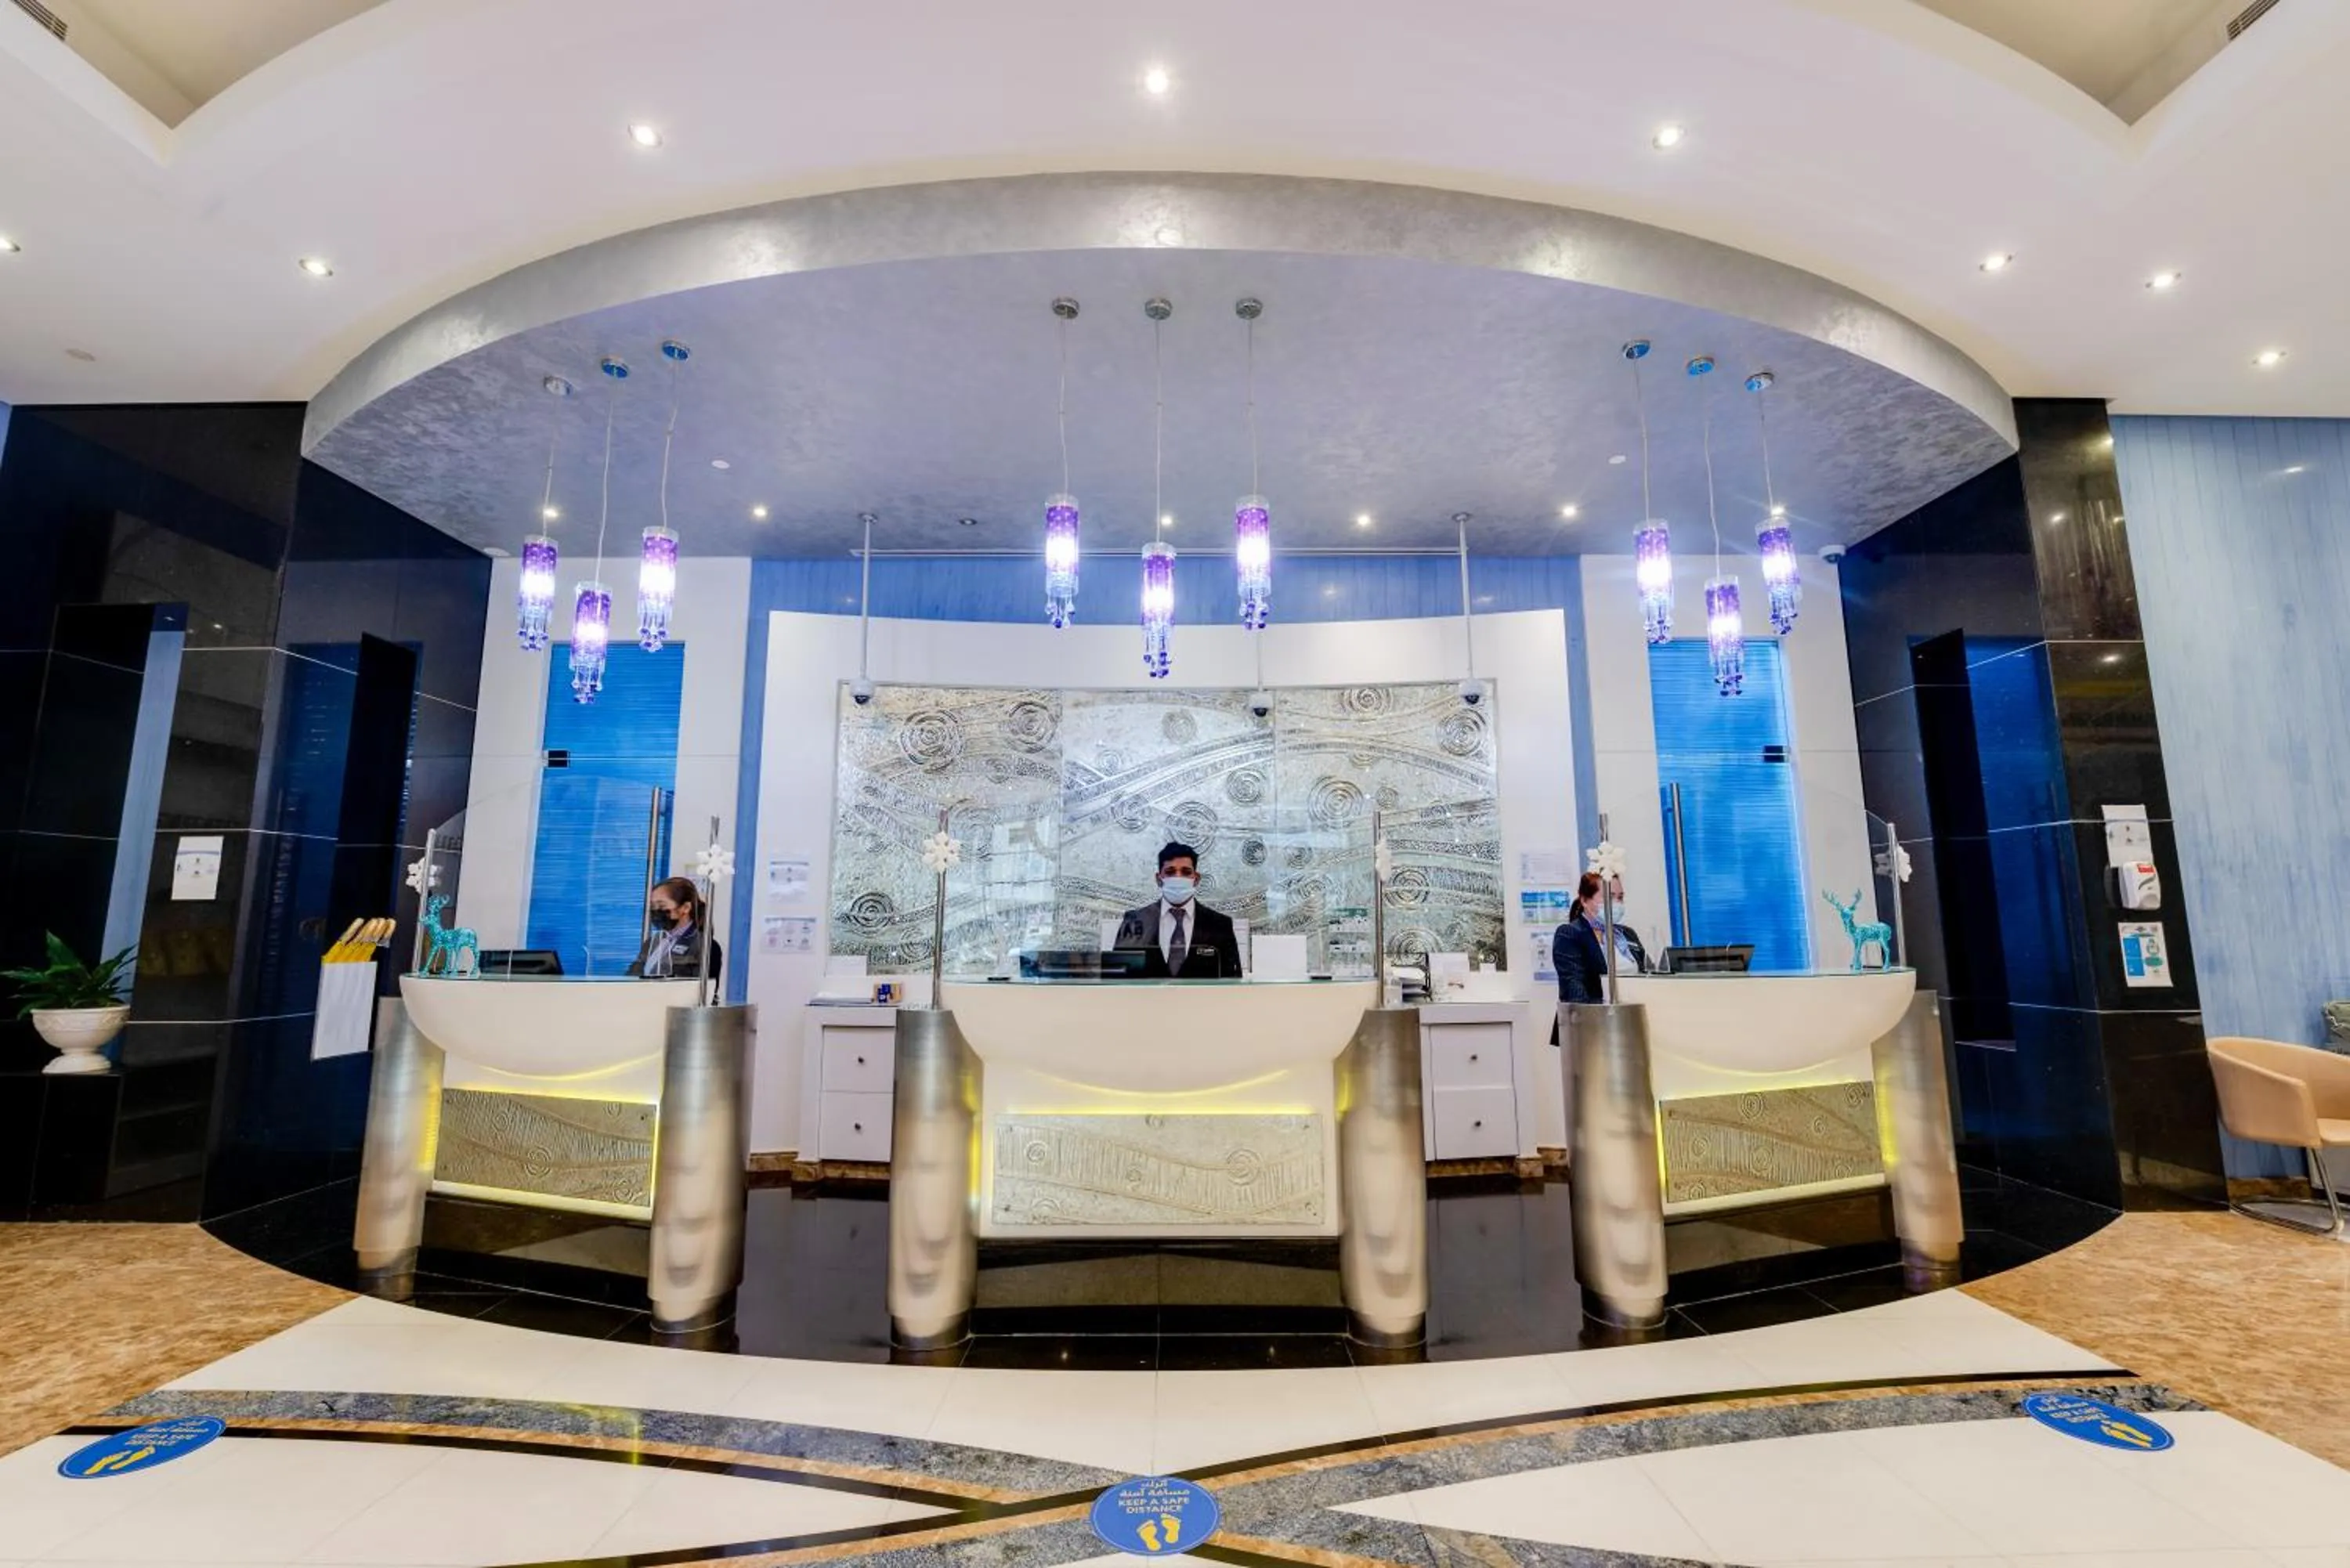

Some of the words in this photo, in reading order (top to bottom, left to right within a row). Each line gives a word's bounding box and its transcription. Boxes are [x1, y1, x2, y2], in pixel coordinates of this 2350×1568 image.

[1118, 1498, 1147, 1507] KEEP
[1162, 1496, 1190, 1505] SAFE
[1126, 1505, 1183, 1514] DISTANCE
